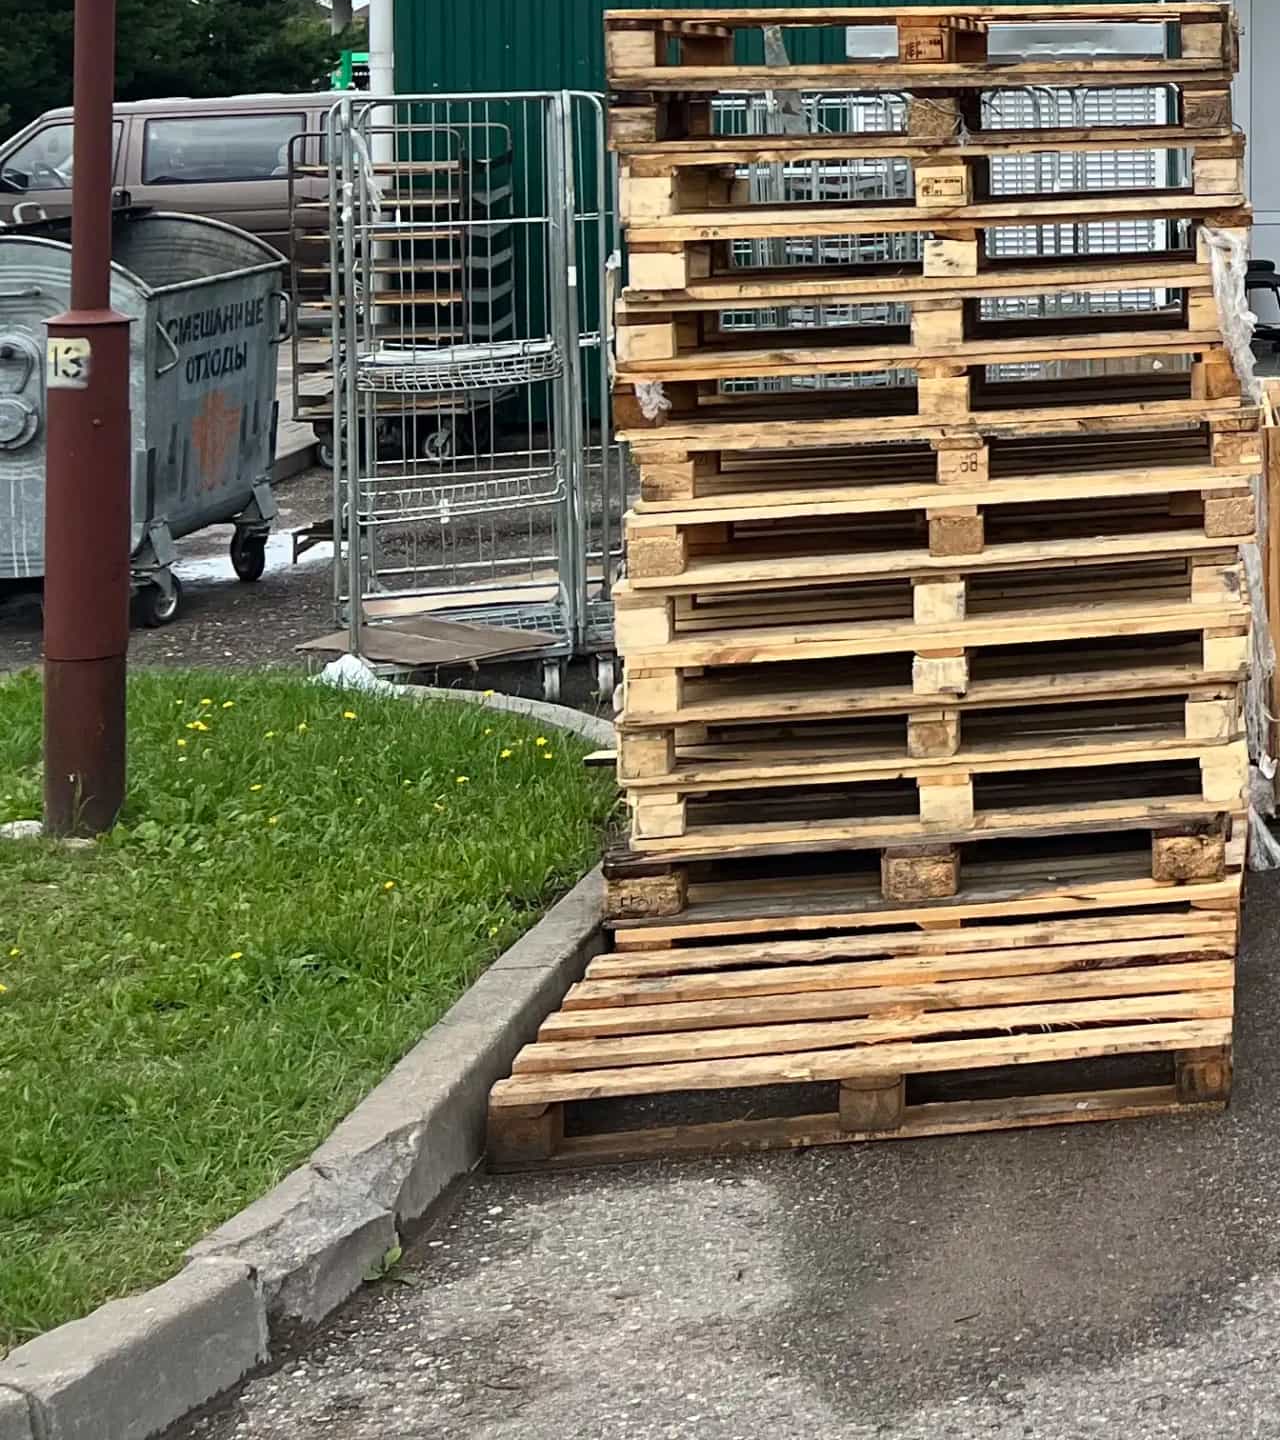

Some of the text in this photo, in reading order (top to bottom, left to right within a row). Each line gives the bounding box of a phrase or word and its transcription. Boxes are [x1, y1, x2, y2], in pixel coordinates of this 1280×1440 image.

[165, 298, 264, 345] СМЕШАННЫЕ
[53, 345, 82, 378] 13
[186, 341, 248, 384] ОТХОДЫ
